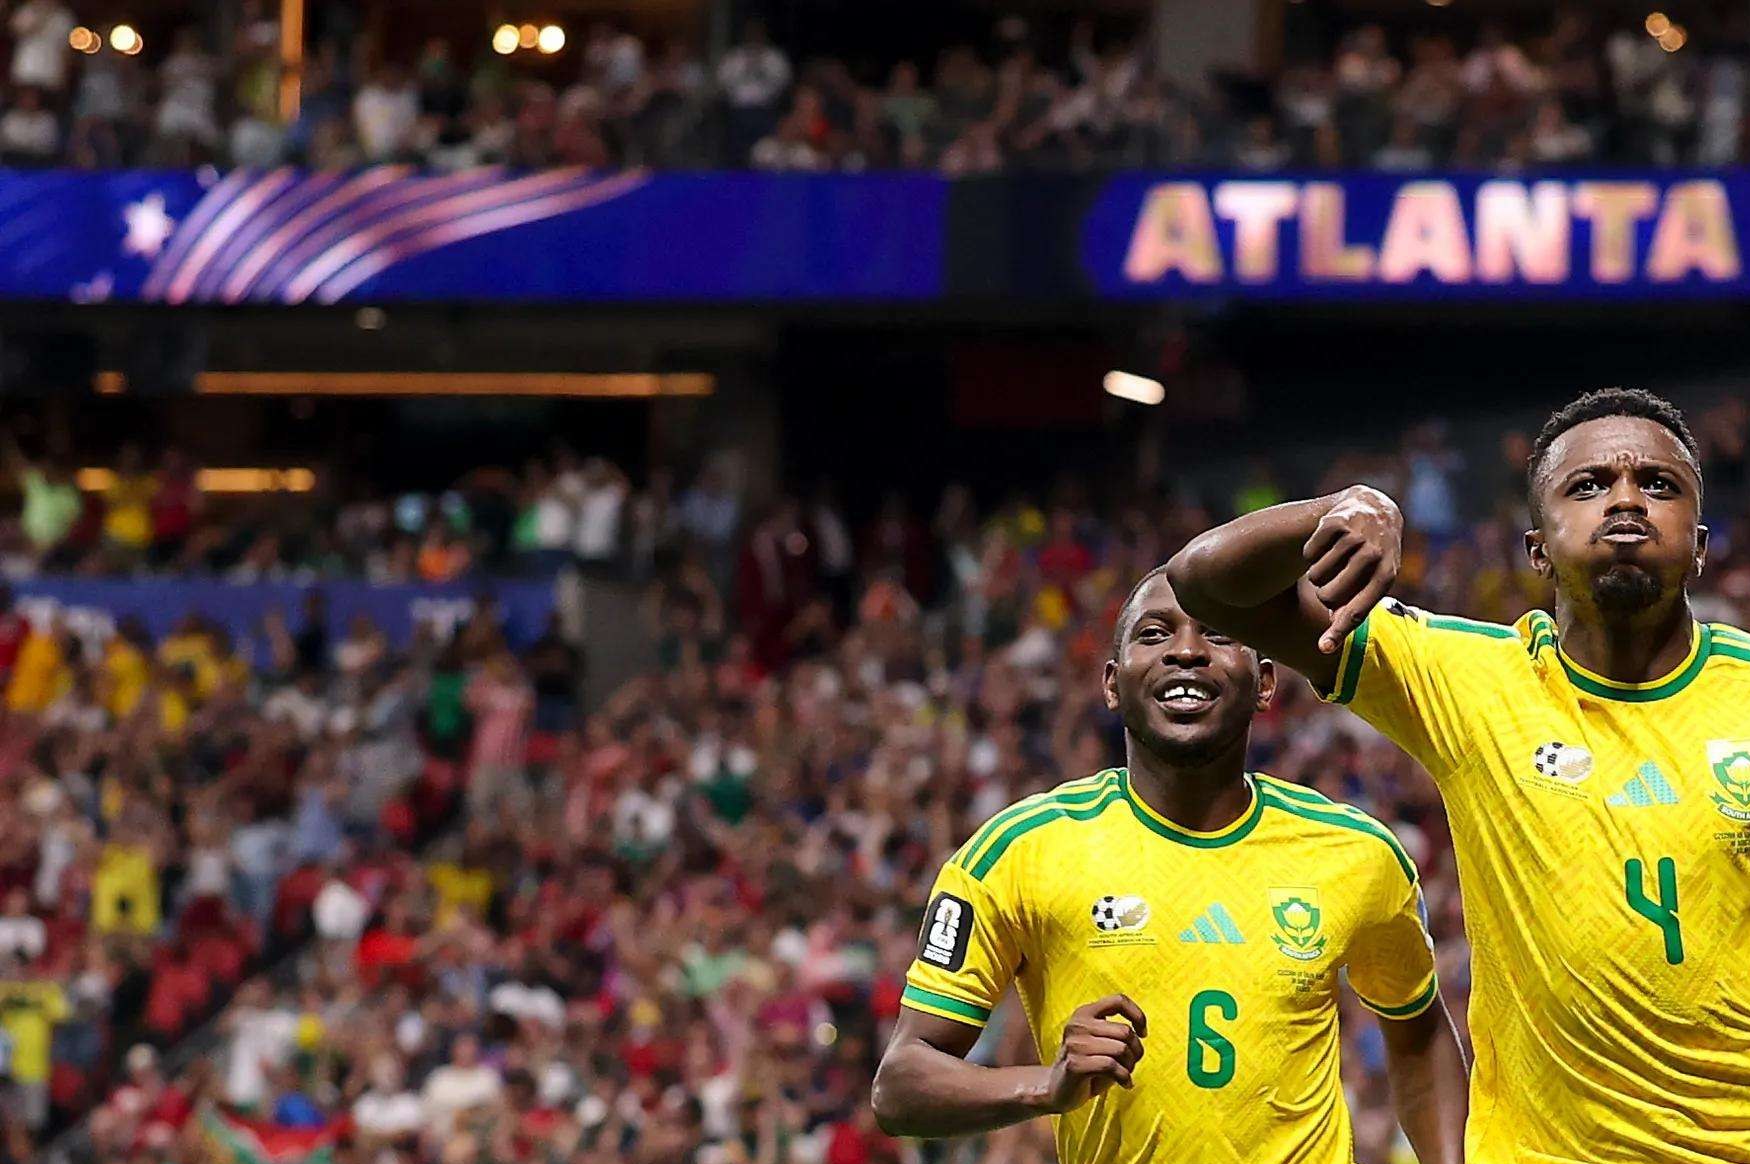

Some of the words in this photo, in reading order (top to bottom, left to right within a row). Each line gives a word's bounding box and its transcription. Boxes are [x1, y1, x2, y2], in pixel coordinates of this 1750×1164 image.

[1124, 182, 1740, 282] ATLANTA
[1624, 856, 1685, 966] 4
[1186, 989, 1238, 1089] 6
